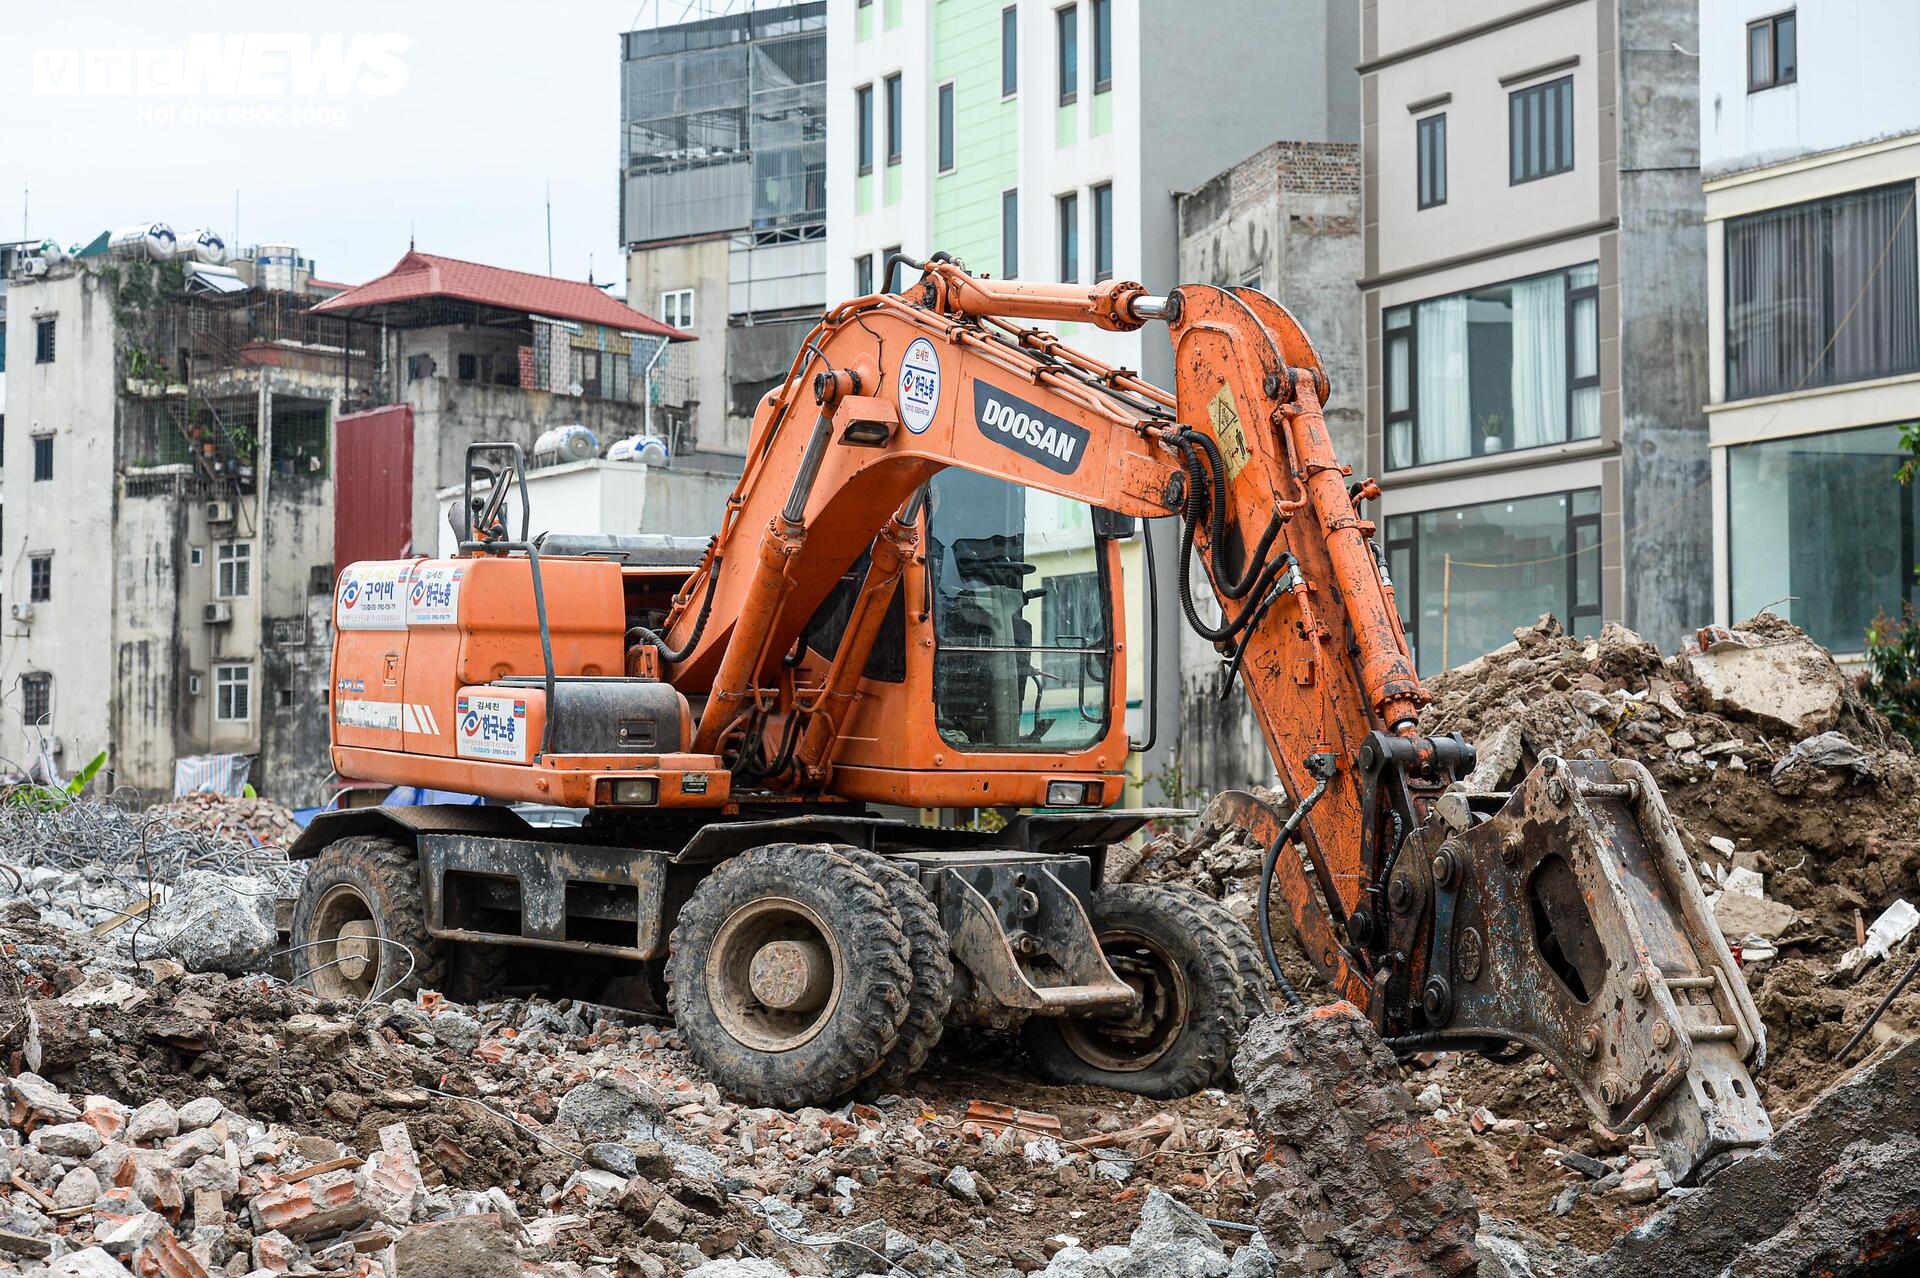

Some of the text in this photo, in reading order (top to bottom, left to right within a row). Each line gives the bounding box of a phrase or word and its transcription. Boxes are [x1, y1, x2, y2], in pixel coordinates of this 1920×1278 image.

[914, 373, 935, 401] 한국노총
[981, 398, 1077, 463] DOOSAN
[365, 580, 395, 601] 구아바
[426, 581, 452, 608] 한국노총
[477, 701, 500, 711] 김세진
[482, 714, 515, 742] 한국노총
